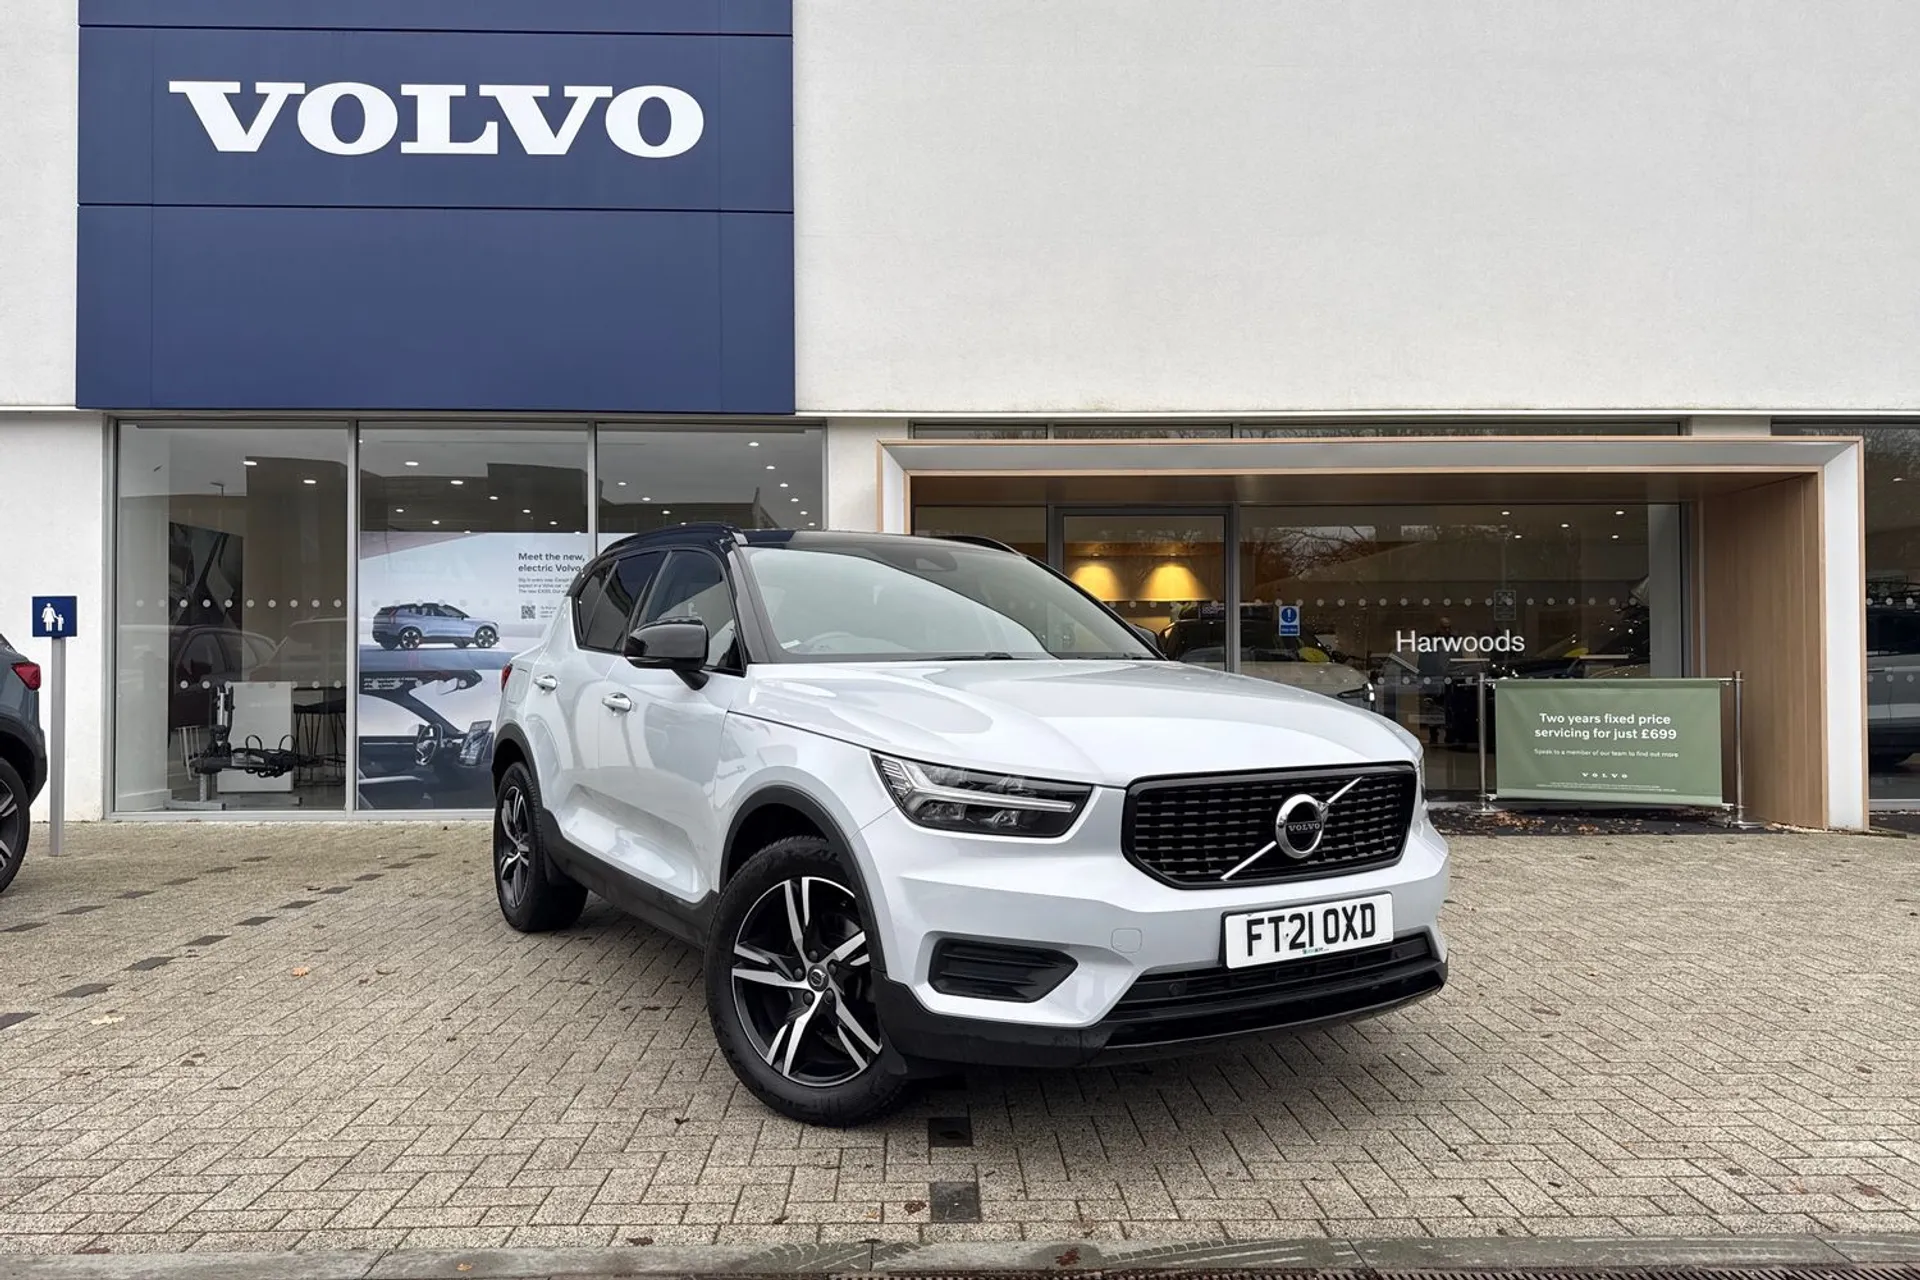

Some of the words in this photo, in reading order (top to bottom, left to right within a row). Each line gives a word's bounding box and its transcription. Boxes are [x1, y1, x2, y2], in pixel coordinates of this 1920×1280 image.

[169, 81, 704, 158] VOLVO
[518, 553, 543, 561] Meet
[545, 553, 561, 561] the
[563, 554, 585, 562] new,
[518, 564, 553, 572] electric
[555, 564, 581, 572] Volvo
[1396, 629, 1525, 652] Harwoods
[1539, 712, 1565, 723] Two
[1567, 715, 1601, 726] years
[1604, 713, 1635, 724] fixed
[1638, 714, 1671, 726] price
[1534, 727, 1590, 740] servicing
[1593, 728, 1611, 738] for
[1613, 728, 1638, 740] just
[1641, 728, 1677, 739] £699
[1288, 822, 1320, 831] VOLVO
[1246, 911, 1315, 957] FT21
[1323, 902, 1376, 945] OXD
